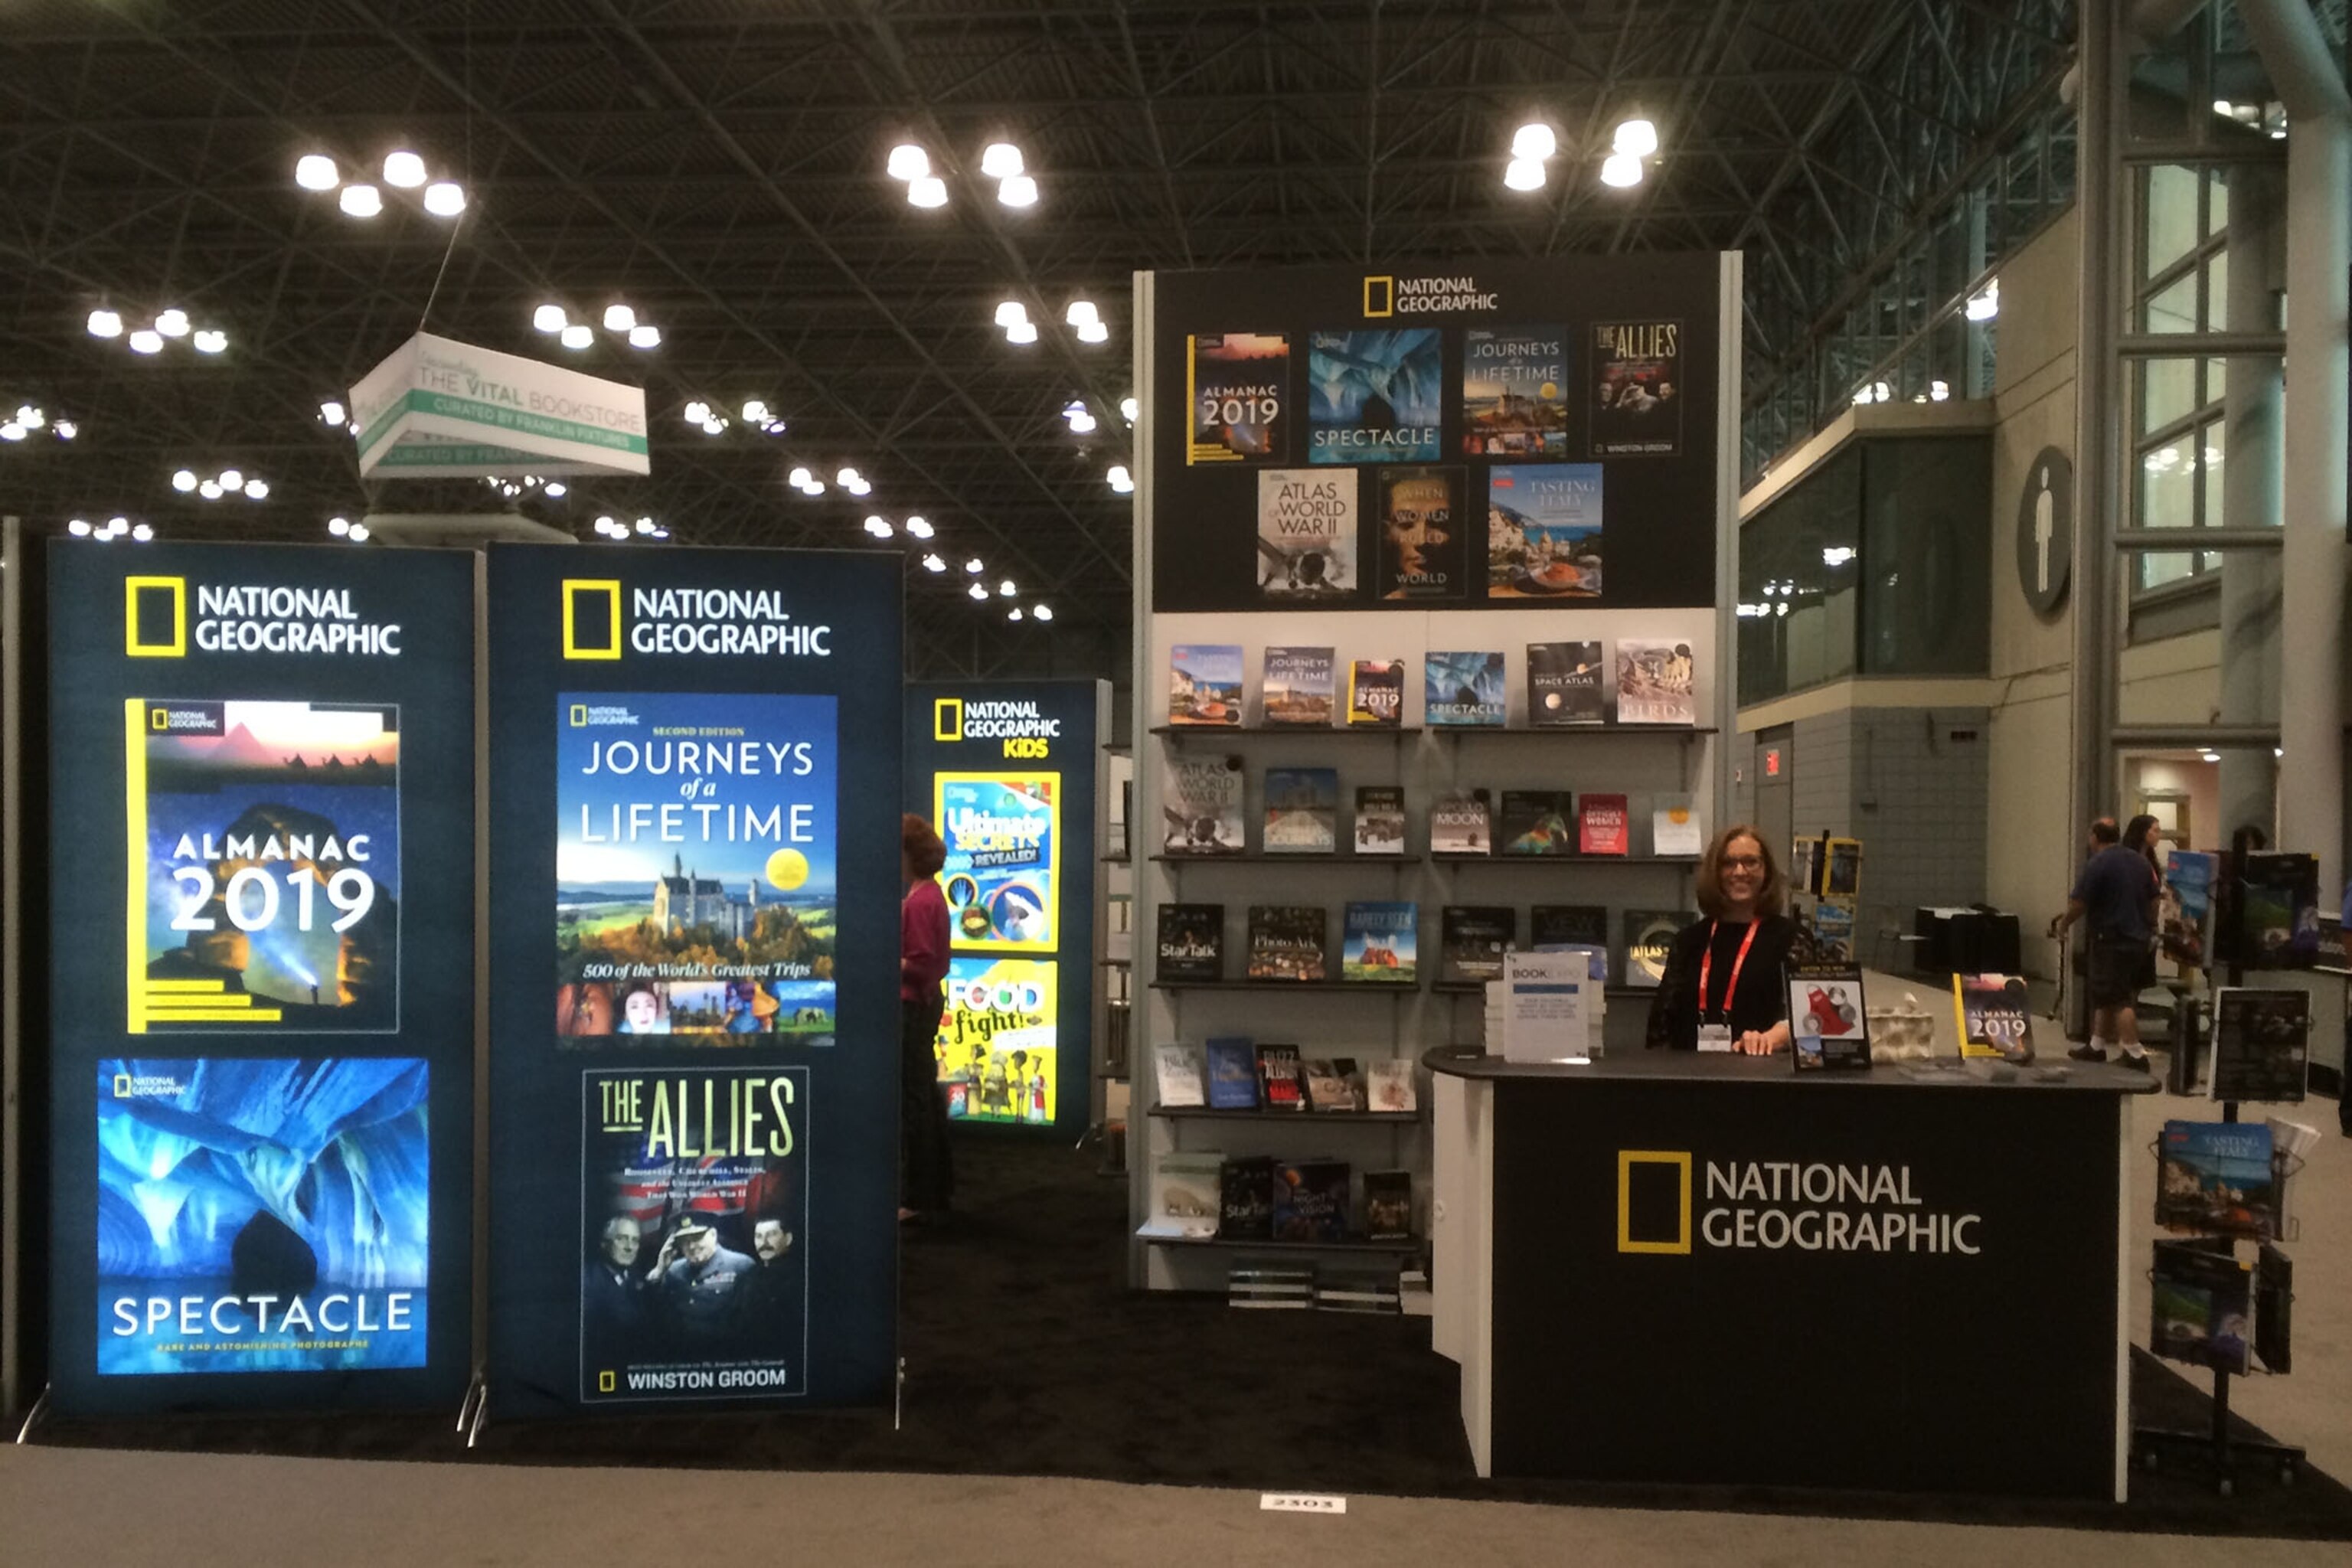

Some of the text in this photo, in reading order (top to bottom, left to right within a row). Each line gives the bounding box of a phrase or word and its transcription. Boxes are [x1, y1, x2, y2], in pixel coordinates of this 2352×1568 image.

[1399, 277, 1477, 295] NATIONAL
[1397, 294, 1498, 313] GEOGRAPHIC
[1474, 342, 1560, 358] JOURNEYS
[1597, 324, 1677, 359] THE ALLIES
[1472, 364, 1560, 381] LIFETIME
[420, 367, 640, 432] THE VITAL BOOKSTORE
[1204, 385, 1278, 398] ALMANAC
[433, 397, 494, 420] CURATED
[497, 410, 514, 425] BY
[1203, 398, 1279, 426] 2019
[1315, 428, 1434, 447] SPECTACLE
[1279, 482, 1337, 500] ATLAS
[1401, 487, 1443, 500] WHEN
[1531, 479, 1596, 494] TASTING
[1279, 500, 1346, 518] WORLD
[1396, 510, 1449, 524] WOMEN
[1279, 518, 1337, 536] WAR II
[1396, 572, 1447, 585] WORLD
[198, 586, 359, 619] NATIONAL
[632, 588, 790, 620] NATIONAL
[195, 620, 401, 655] GEOGRAPHIC
[631, 623, 831, 656] GEOGRAPHIC
[1535, 676, 1594, 687] SPACE ATLAS
[965, 701, 1040, 719] NATIONAL
[1357, 694, 1400, 707] 2019
[1429, 704, 1501, 715] SPECTACLE
[168, 710, 207, 720] NATIONAL
[168, 718, 217, 728] GEOGRAPHIC
[652, 727, 745, 737] SECOND EDITION
[963, 719, 1061, 738] GEOGRAPHIC
[582, 740, 814, 776] JOURNEYS
[680, 777, 717, 800] of a
[581, 803, 815, 842] LIFETIME
[1436, 813, 1484, 825] MOON
[172, 832, 371, 863] ALMANAC
[974, 848, 1037, 867] REVEALED!
[168, 866, 376, 933] 2019
[582, 962, 613, 979] 500
[615, 962, 631, 980] of
[632, 962, 655, 978] the
[711, 962, 770, 977] Greatest
[773, 961, 812, 978] Trips
[947, 978, 1044, 1013] FOOD
[1970, 1010, 2024, 1019] ALMANAC
[954, 1008, 1024, 1044] fight!
[1972, 1019, 2027, 1037] 2019
[599, 1076, 795, 1158] THE ALLIES
[1706, 1161, 1922, 1205] NATIONAL
[1702, 1207, 1981, 1255] GEOGRAPHIC
[112, 1292, 413, 1337] SPECTACLE
[157, 1344, 185, 1353] RARE
[188, 1343, 211, 1351] AND
[627, 1368, 786, 1390] WINSTON GROOM
